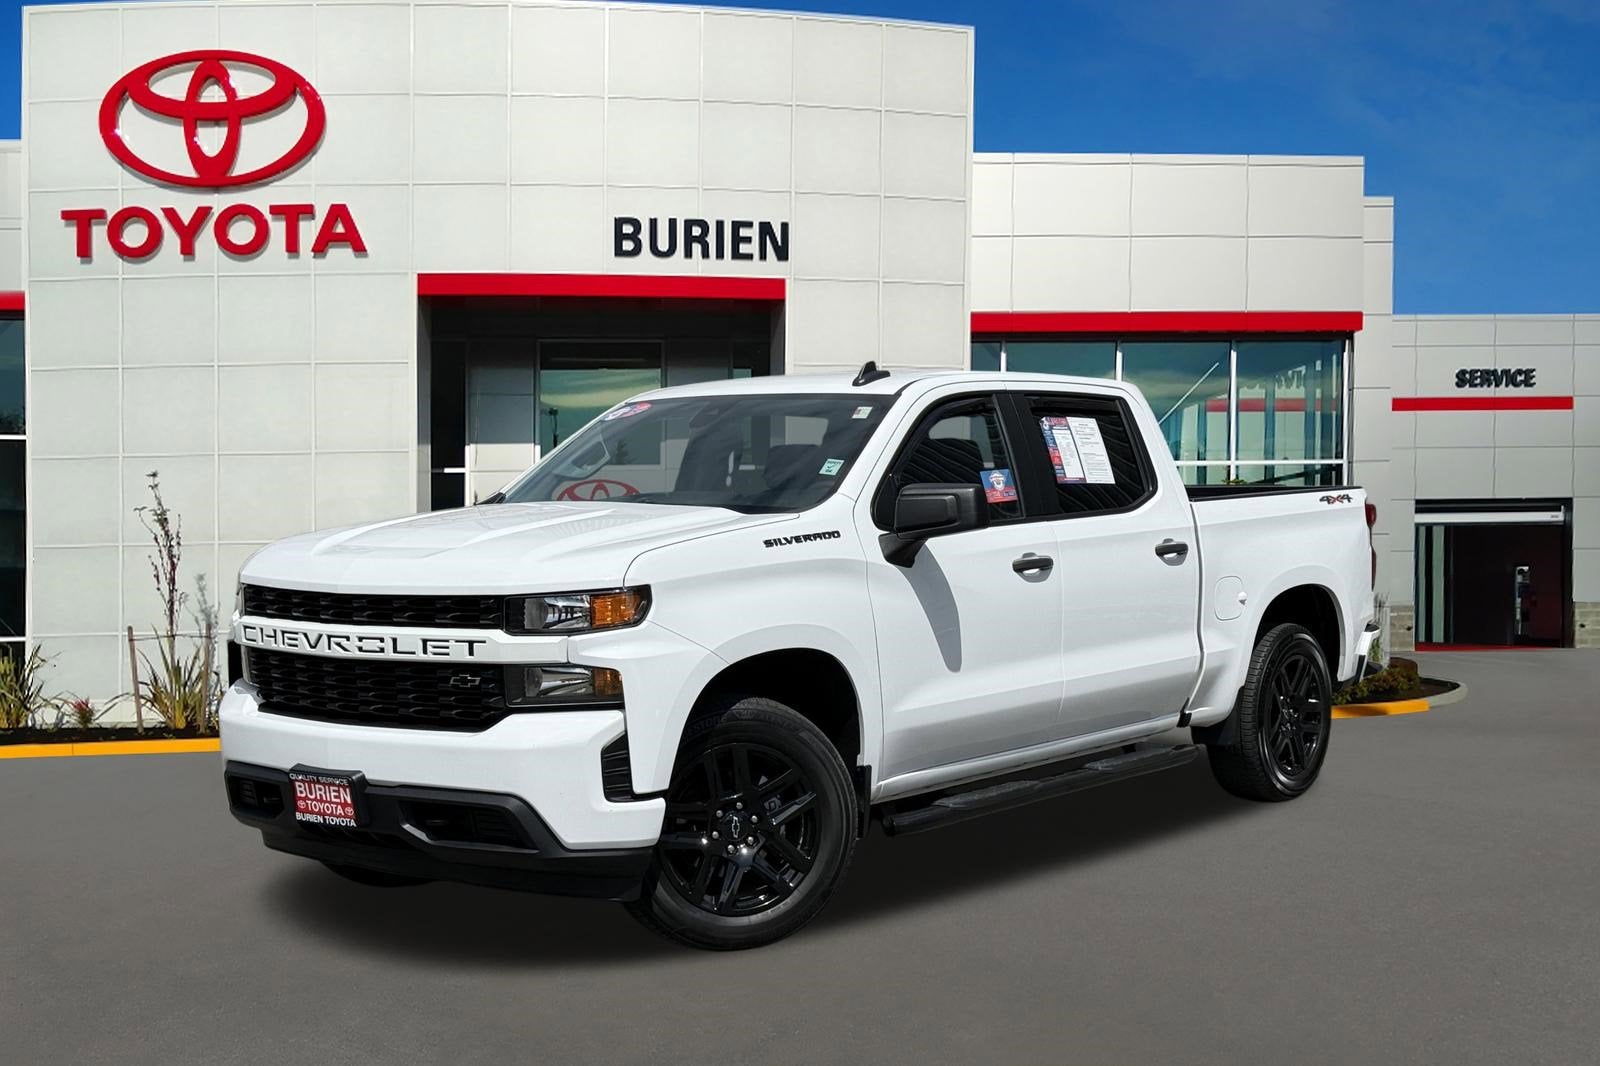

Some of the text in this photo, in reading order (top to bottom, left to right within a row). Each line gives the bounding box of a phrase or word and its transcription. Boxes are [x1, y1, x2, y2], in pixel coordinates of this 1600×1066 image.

[61, 203, 368, 258] TOYOTA
[614, 217, 790, 262] BURIEN
[1455, 368, 1537, 389] SERVICE
[763, 530, 841, 548] SILVERADO
[242, 624, 487, 657] CHEVROLET
[289, 773, 318, 782] QUALITY
[295, 781, 352, 804] BURIEN
[306, 800, 345, 816] TOYOTA
[295, 811, 357, 828] BURIEN TOYOTA
